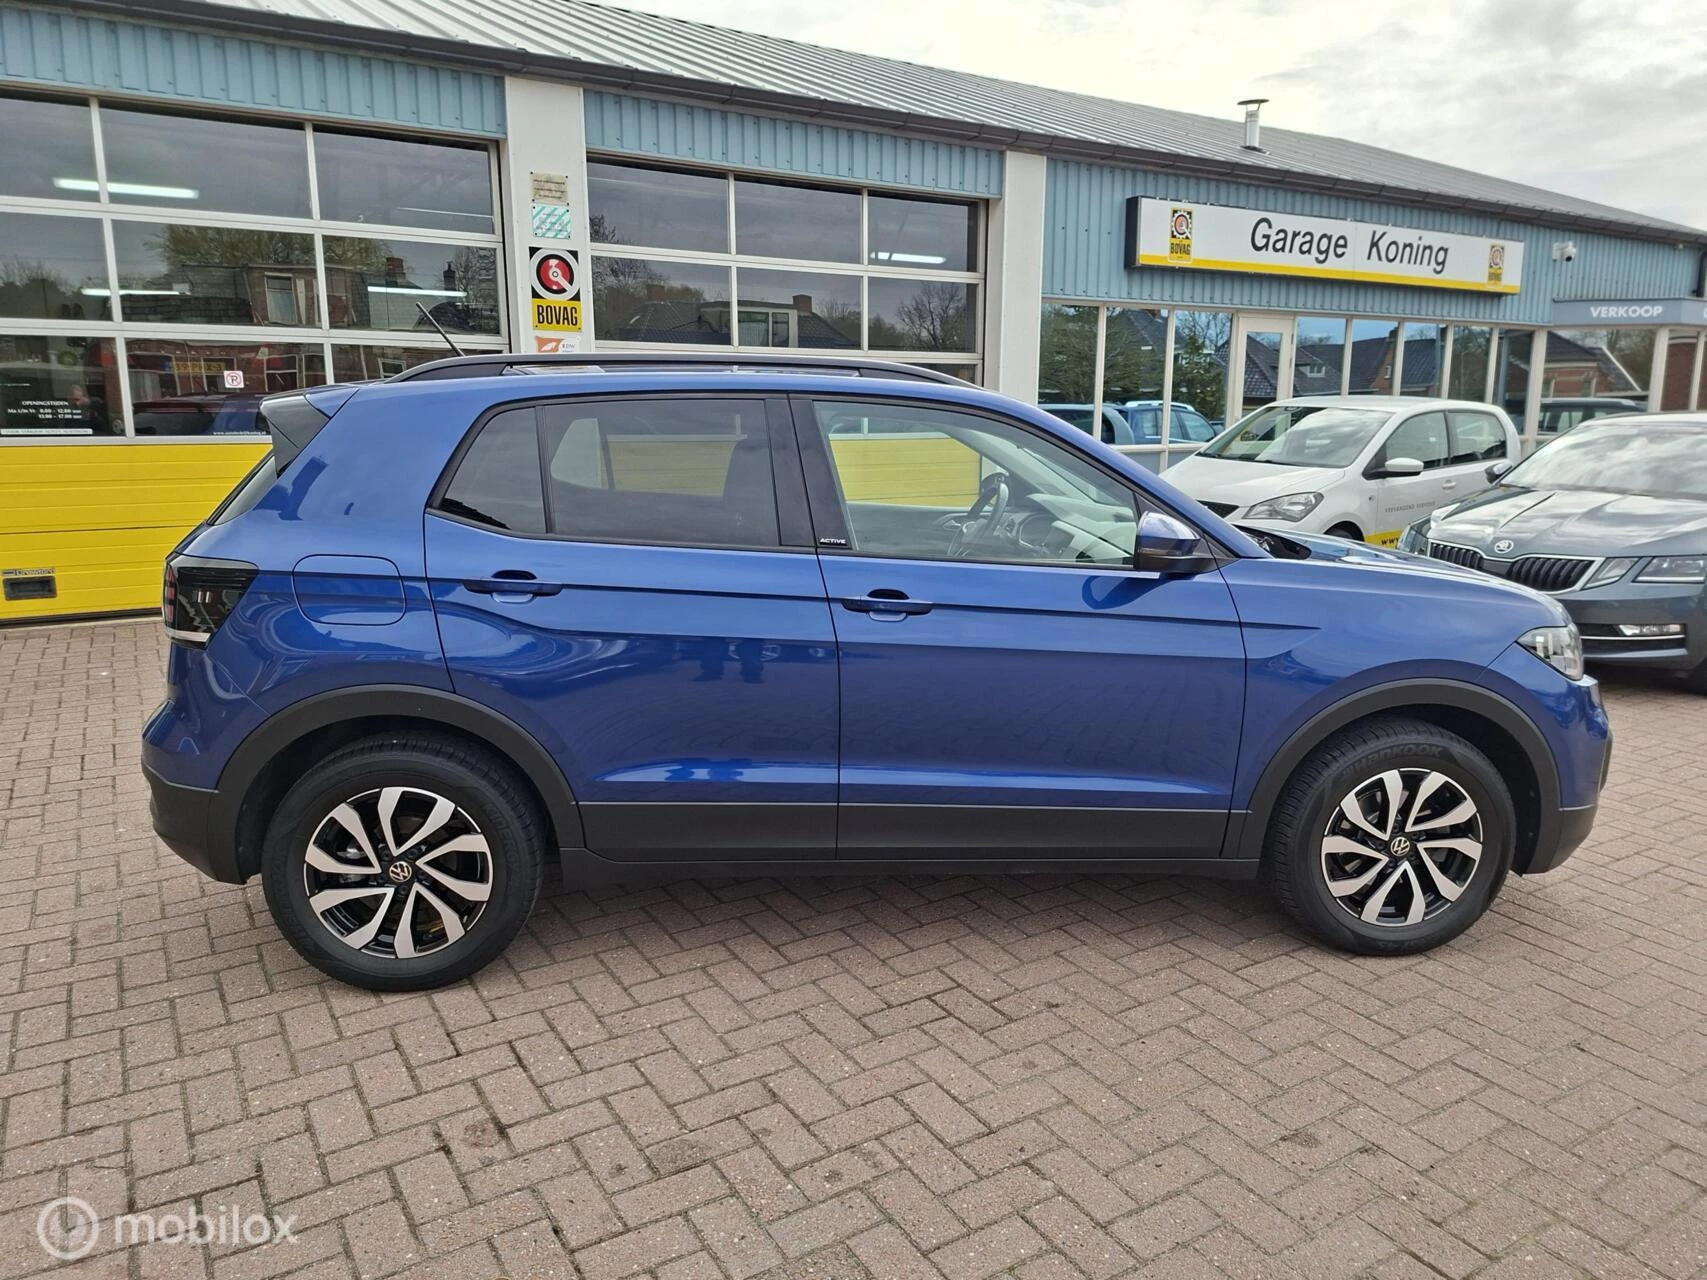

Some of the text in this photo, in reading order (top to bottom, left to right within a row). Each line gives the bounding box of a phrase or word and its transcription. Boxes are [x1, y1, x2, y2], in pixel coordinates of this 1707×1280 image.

[1170, 242, 1191, 256] BOVAG
[1250, 217, 1449, 275] Garage Koning
[536, 304, 578, 326] BOVAG
[1590, 305, 1663, 318] VERKOOP
